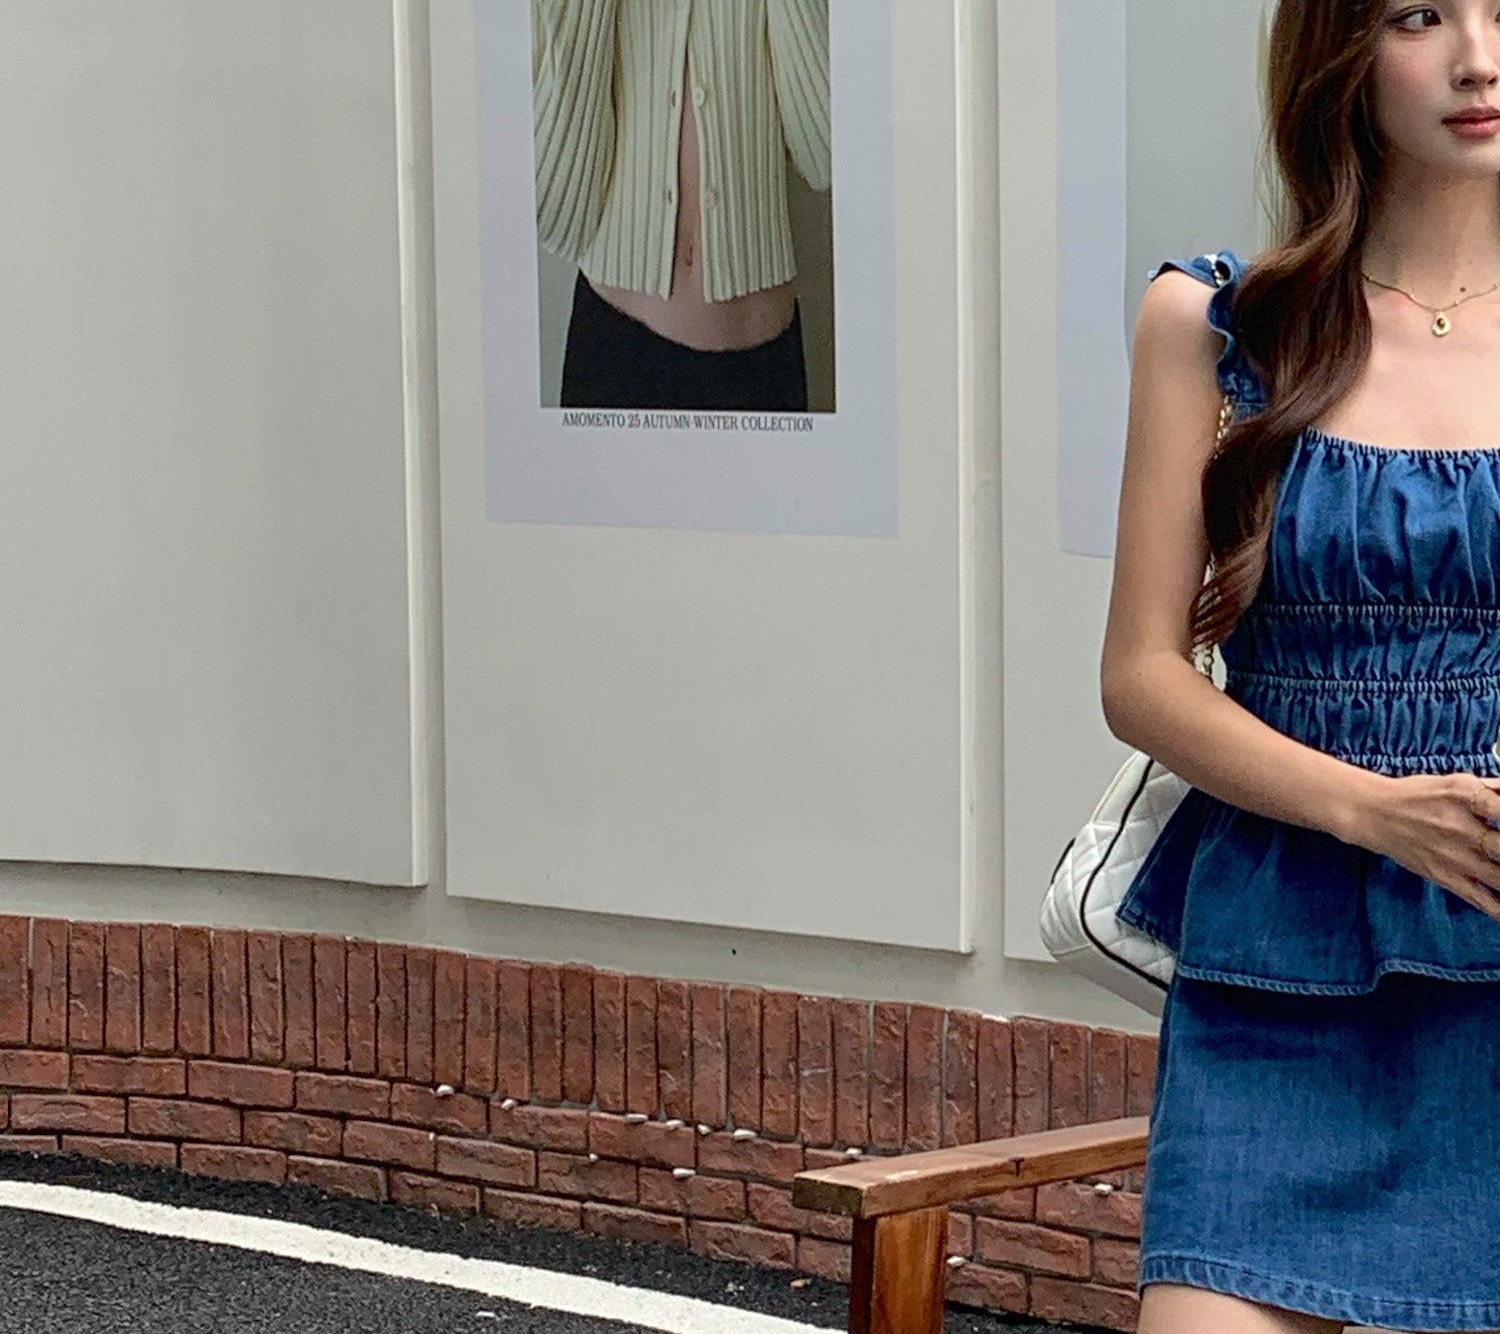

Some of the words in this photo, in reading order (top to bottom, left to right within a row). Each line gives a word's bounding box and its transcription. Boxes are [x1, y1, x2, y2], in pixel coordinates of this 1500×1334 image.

[562, 412, 626, 428] AMOMENTO
[627, 413, 641, 429] 25
[643, 414, 739, 430] AUTUMN-WINTER
[741, 416, 814, 433] COLLECTION
